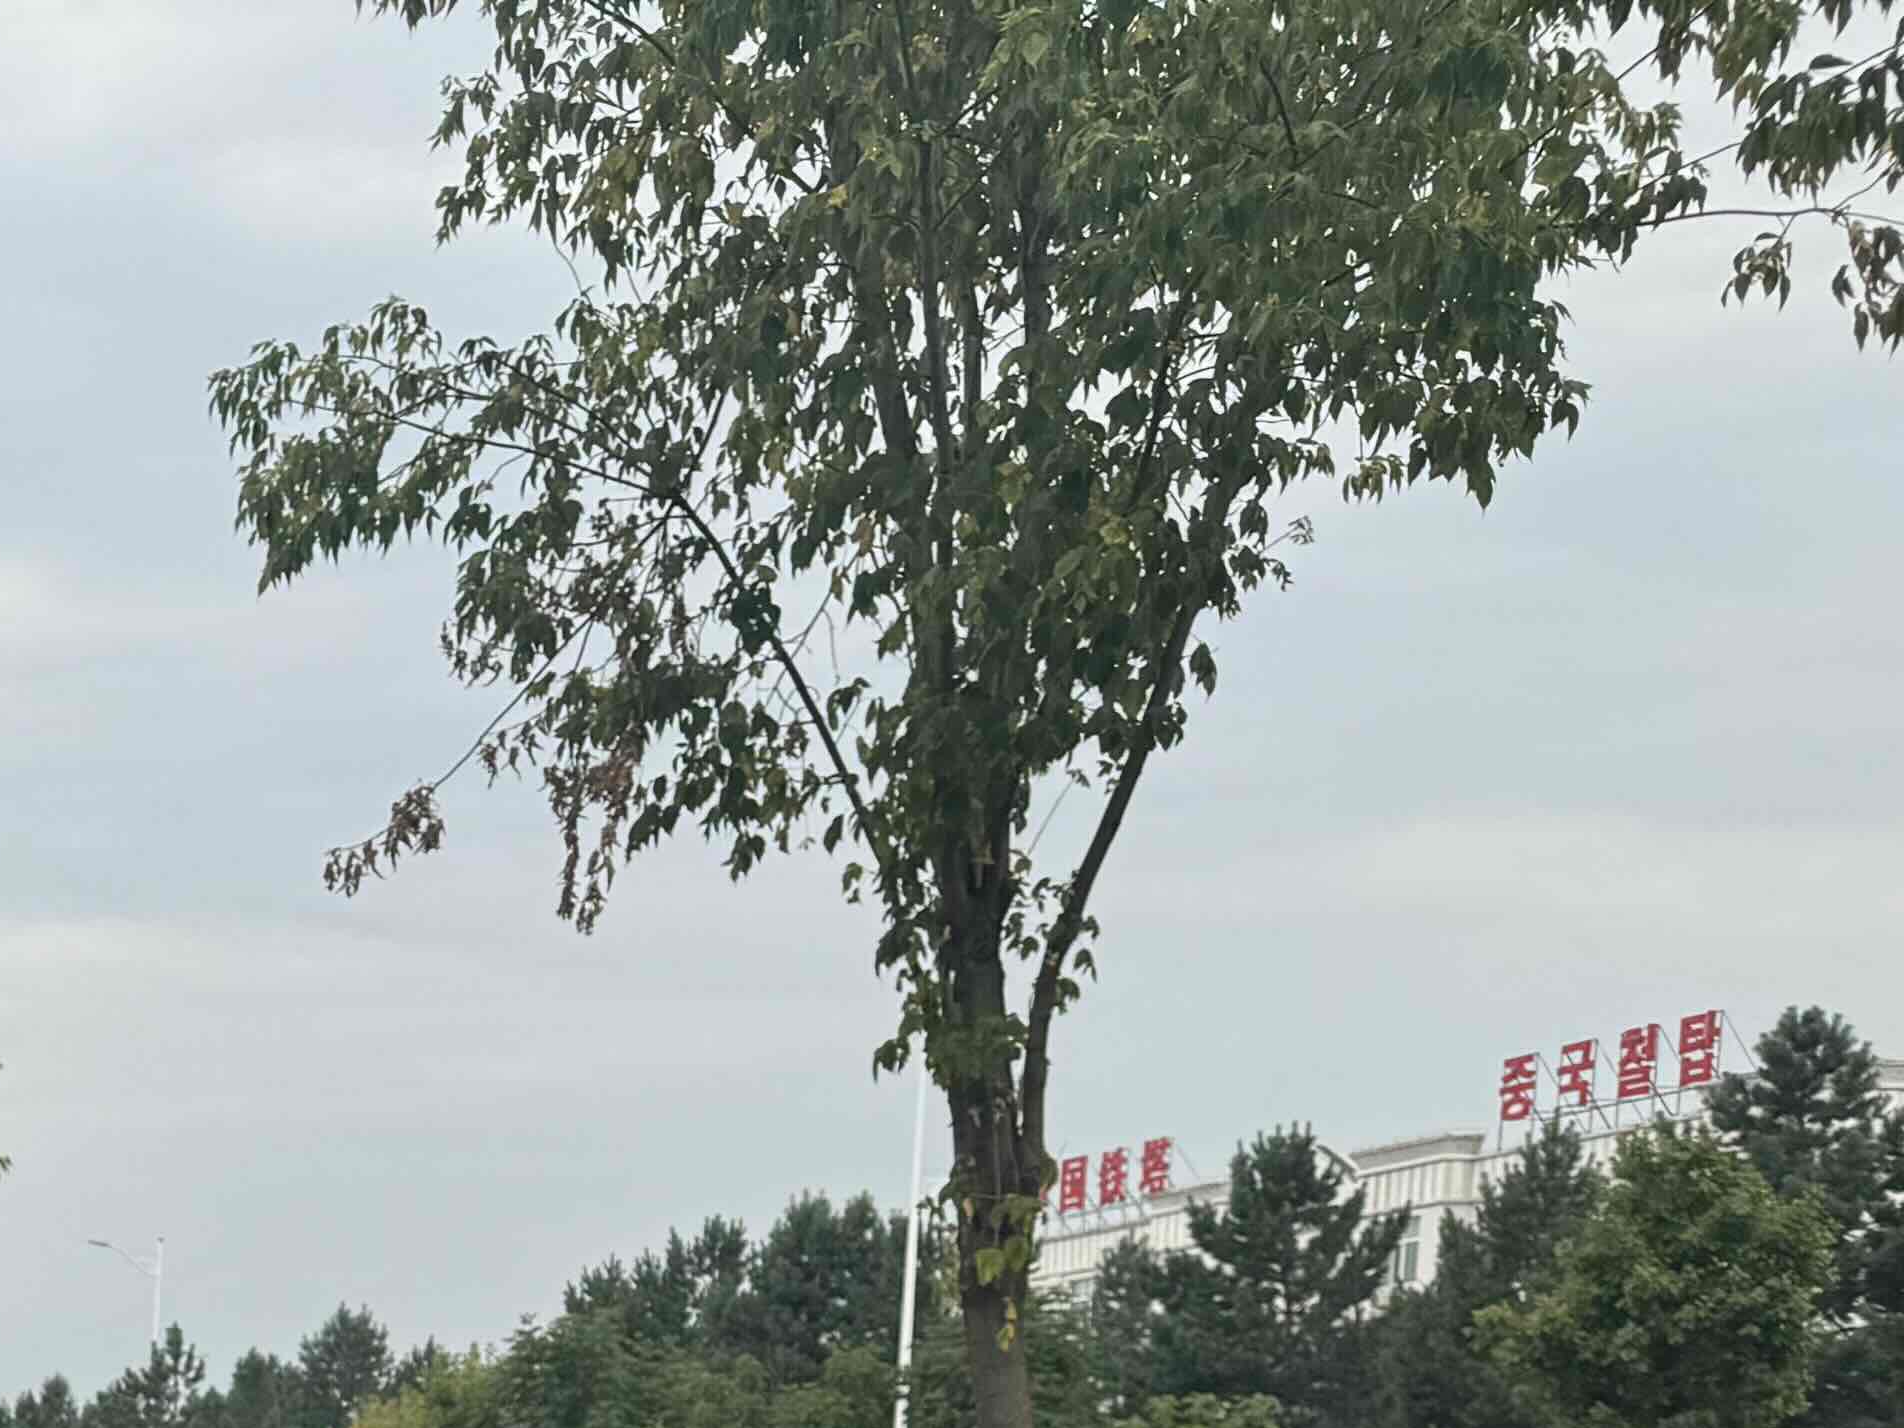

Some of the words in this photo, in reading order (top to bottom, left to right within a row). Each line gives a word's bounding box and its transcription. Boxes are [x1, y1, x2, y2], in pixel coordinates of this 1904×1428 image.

[1499, 1010, 1720, 1120] 중국철탑
[1040, 1137, 1172, 1213] 国铁塔
